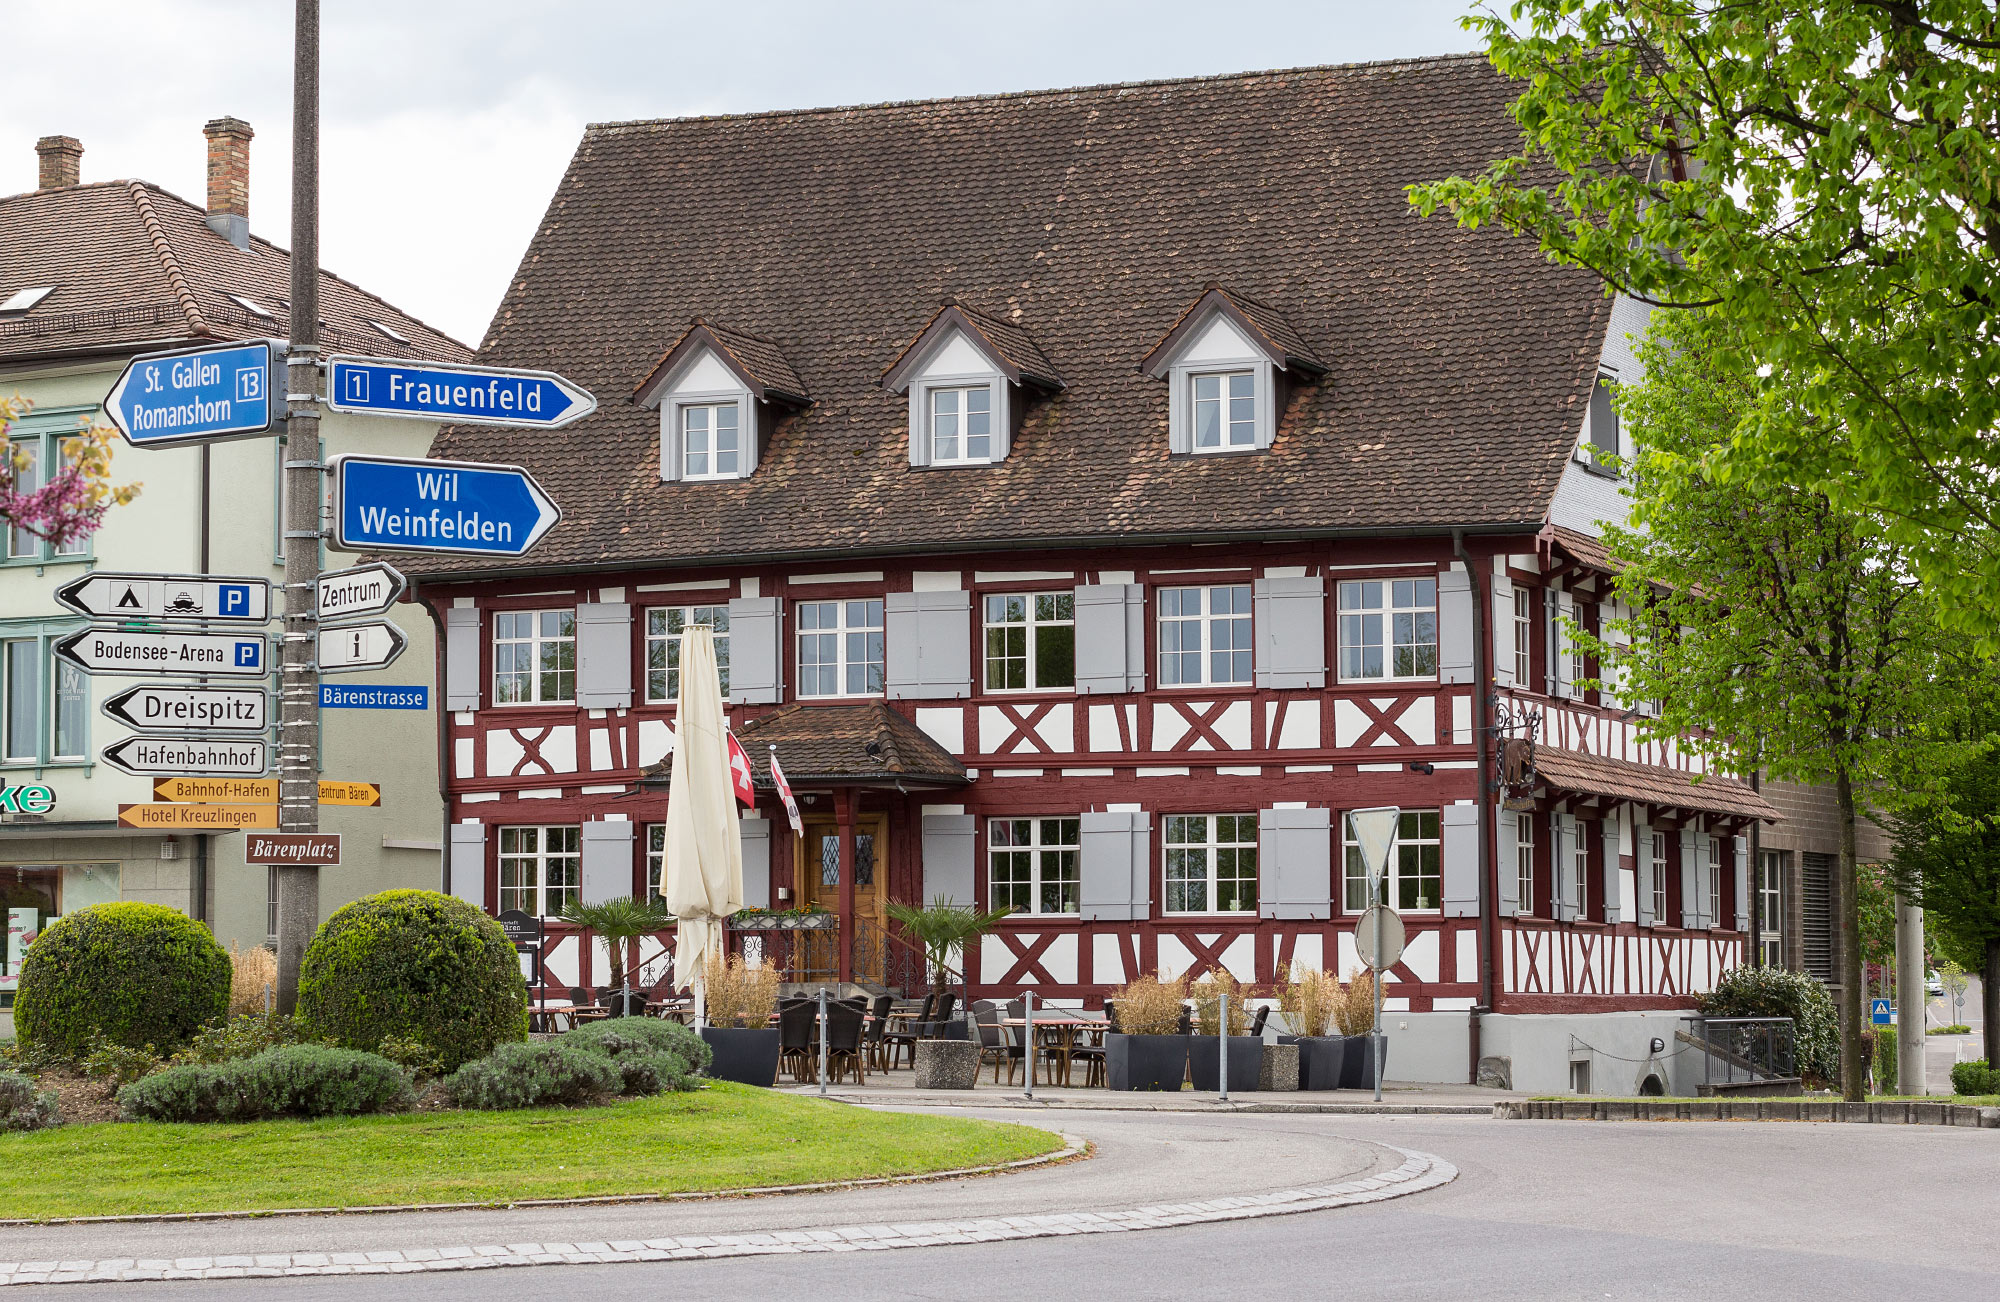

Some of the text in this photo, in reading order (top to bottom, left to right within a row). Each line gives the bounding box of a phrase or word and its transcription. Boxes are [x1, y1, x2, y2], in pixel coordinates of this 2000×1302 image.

[145, 358, 221, 393] St. Gallen
[241, 372, 259, 397] 13
[352, 375, 361, 397] 1
[389, 374, 541, 412] Frauenfeld
[133, 395, 231, 431] Romanshorn
[416, 472, 458, 502] Wil
[359, 505, 512, 543] Weinfelden
[227, 590, 242, 612] P
[322, 581, 381, 608] Zentrum
[95, 640, 224, 662] Bodensee-Arena
[241, 646, 253, 664] P
[323, 687, 423, 706] Bärenstrasse
[145, 695, 256, 725] Dreispitz
[137, 745, 256, 766] Hafenbahnhof
[177, 782, 270, 797] Bahnhof-Hafen
[317, 783, 369, 800] Zentrum Bären
[142, 807, 257, 826] Hotel Kreuzlingen
